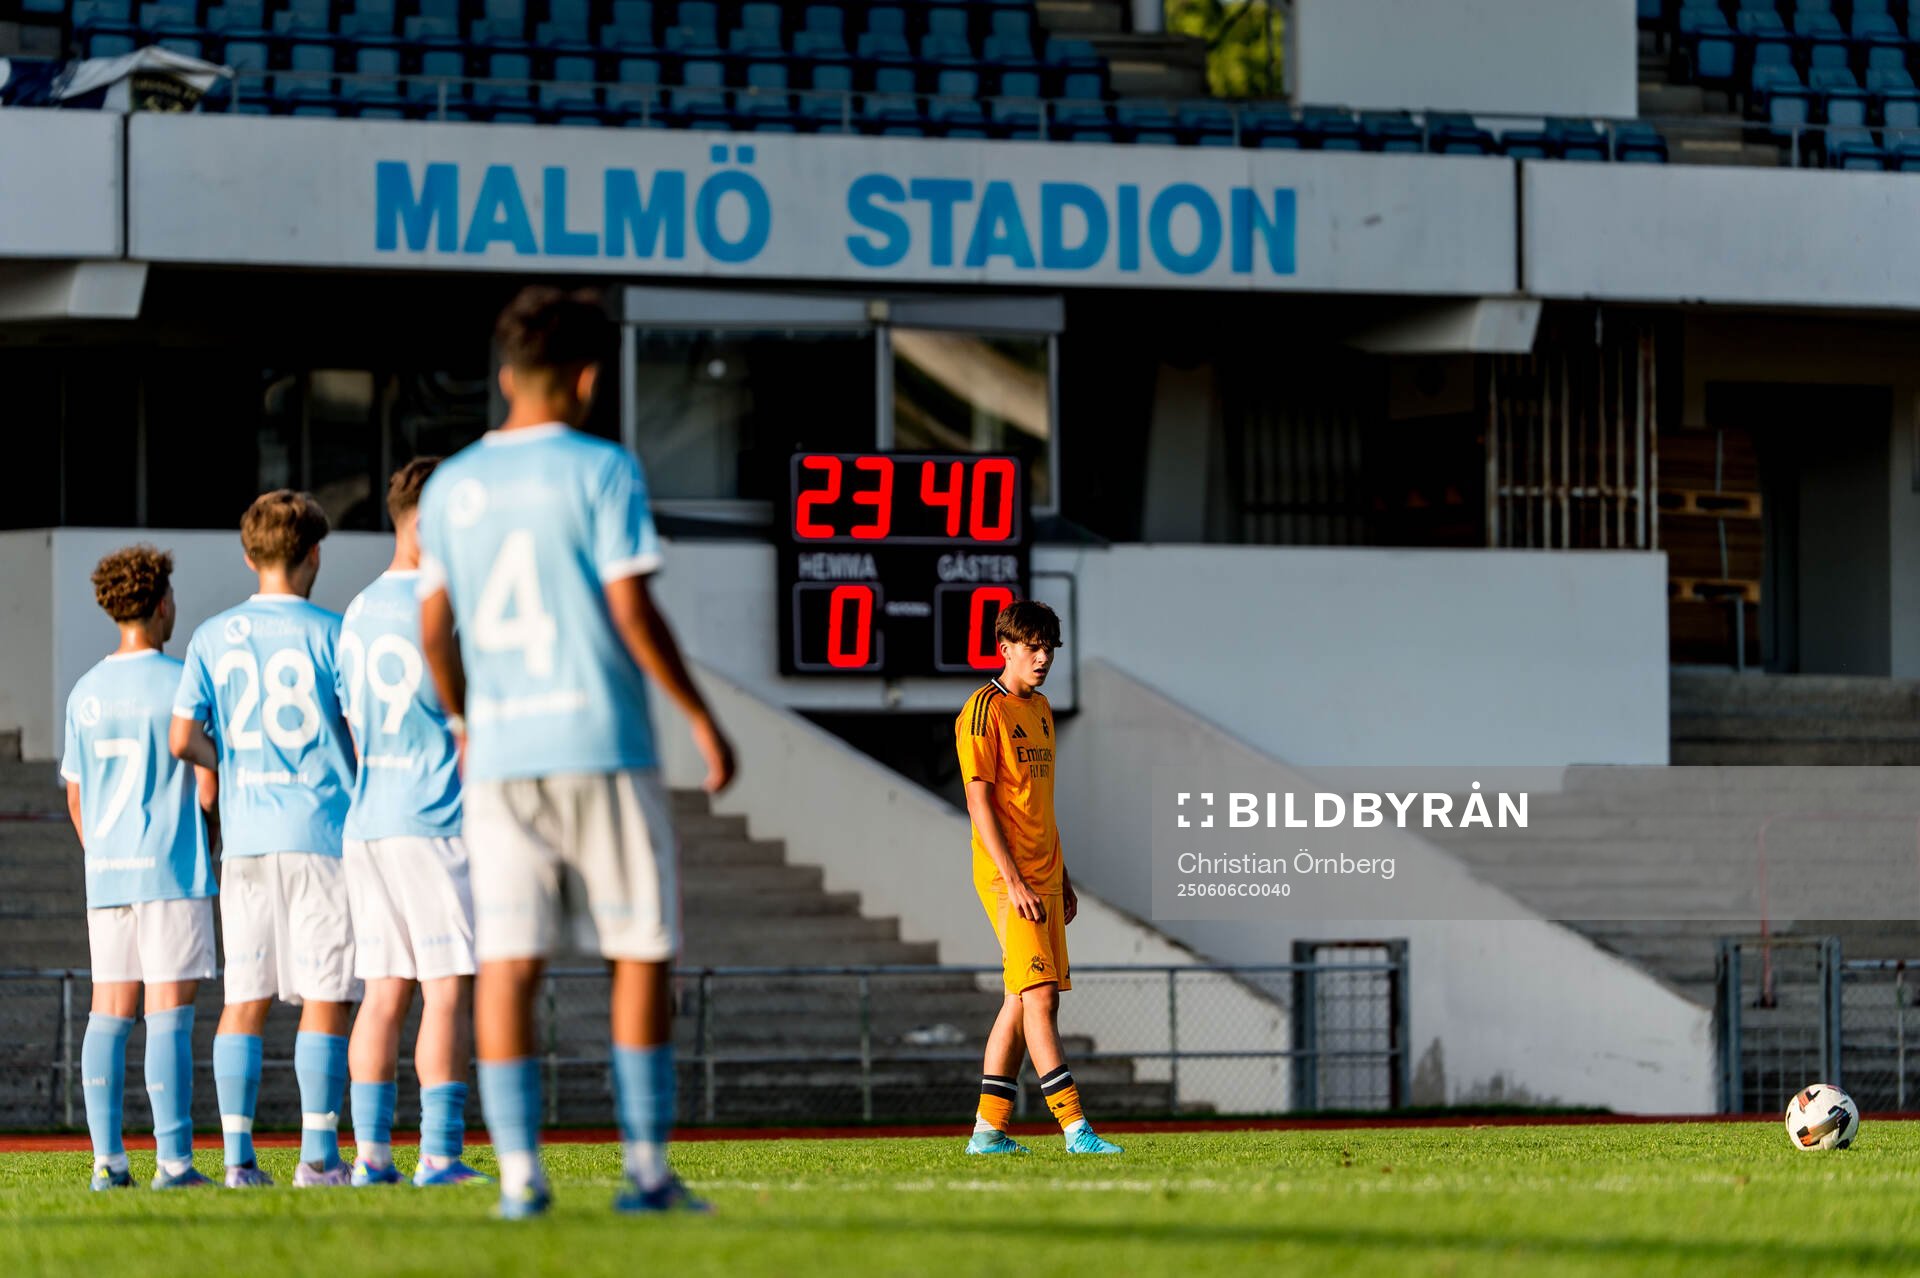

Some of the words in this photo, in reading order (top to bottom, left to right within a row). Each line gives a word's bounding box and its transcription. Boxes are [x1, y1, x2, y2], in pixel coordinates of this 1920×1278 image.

[376, 145, 772, 264] MALMÖ
[846, 173, 1297, 275] STADION
[796, 455, 894, 539] 23
[920, 458, 1015, 541] 40
[474, 529, 557, 679] 4
[827, 585, 873, 667] 0
[967, 587, 1014, 669] 0
[215, 648, 321, 750] 28
[94, 738, 143, 839] 7
